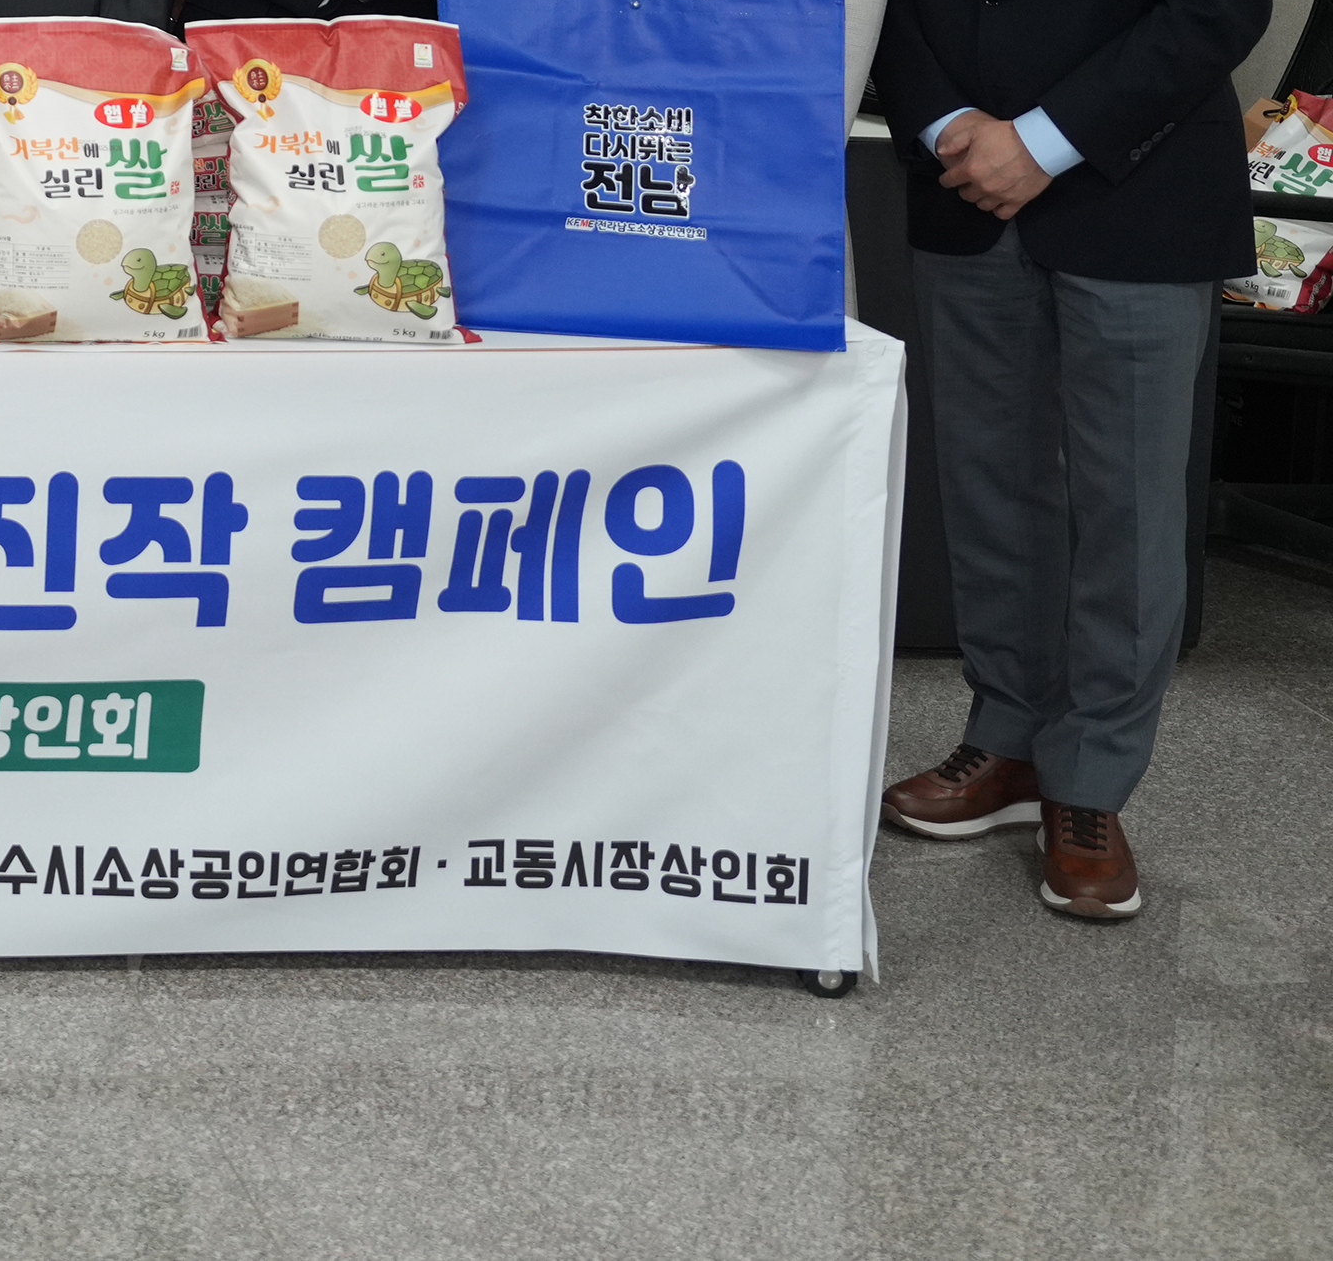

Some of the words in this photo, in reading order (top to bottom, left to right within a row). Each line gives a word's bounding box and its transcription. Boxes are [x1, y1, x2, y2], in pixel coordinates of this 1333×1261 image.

[203, 101, 235, 133] 쌀
[105, 138, 167, 199] 쌀
[285, 162, 346, 193] 실린
[346, 133, 414, 192] 쌀
[40, 168, 104, 199] 실린
[581, 161, 695, 218] 전남
[596, 220, 707, 238] 전라남도소상공인연합회
[143, 330, 150, 338] 5
[152, 330, 165, 339] kg
[392, 328, 399, 336] 5
[402, 328, 416, 338] kg
[291, 459, 746, 624] 캠페인
[463, 838, 811, 906] 교동시장상인회
